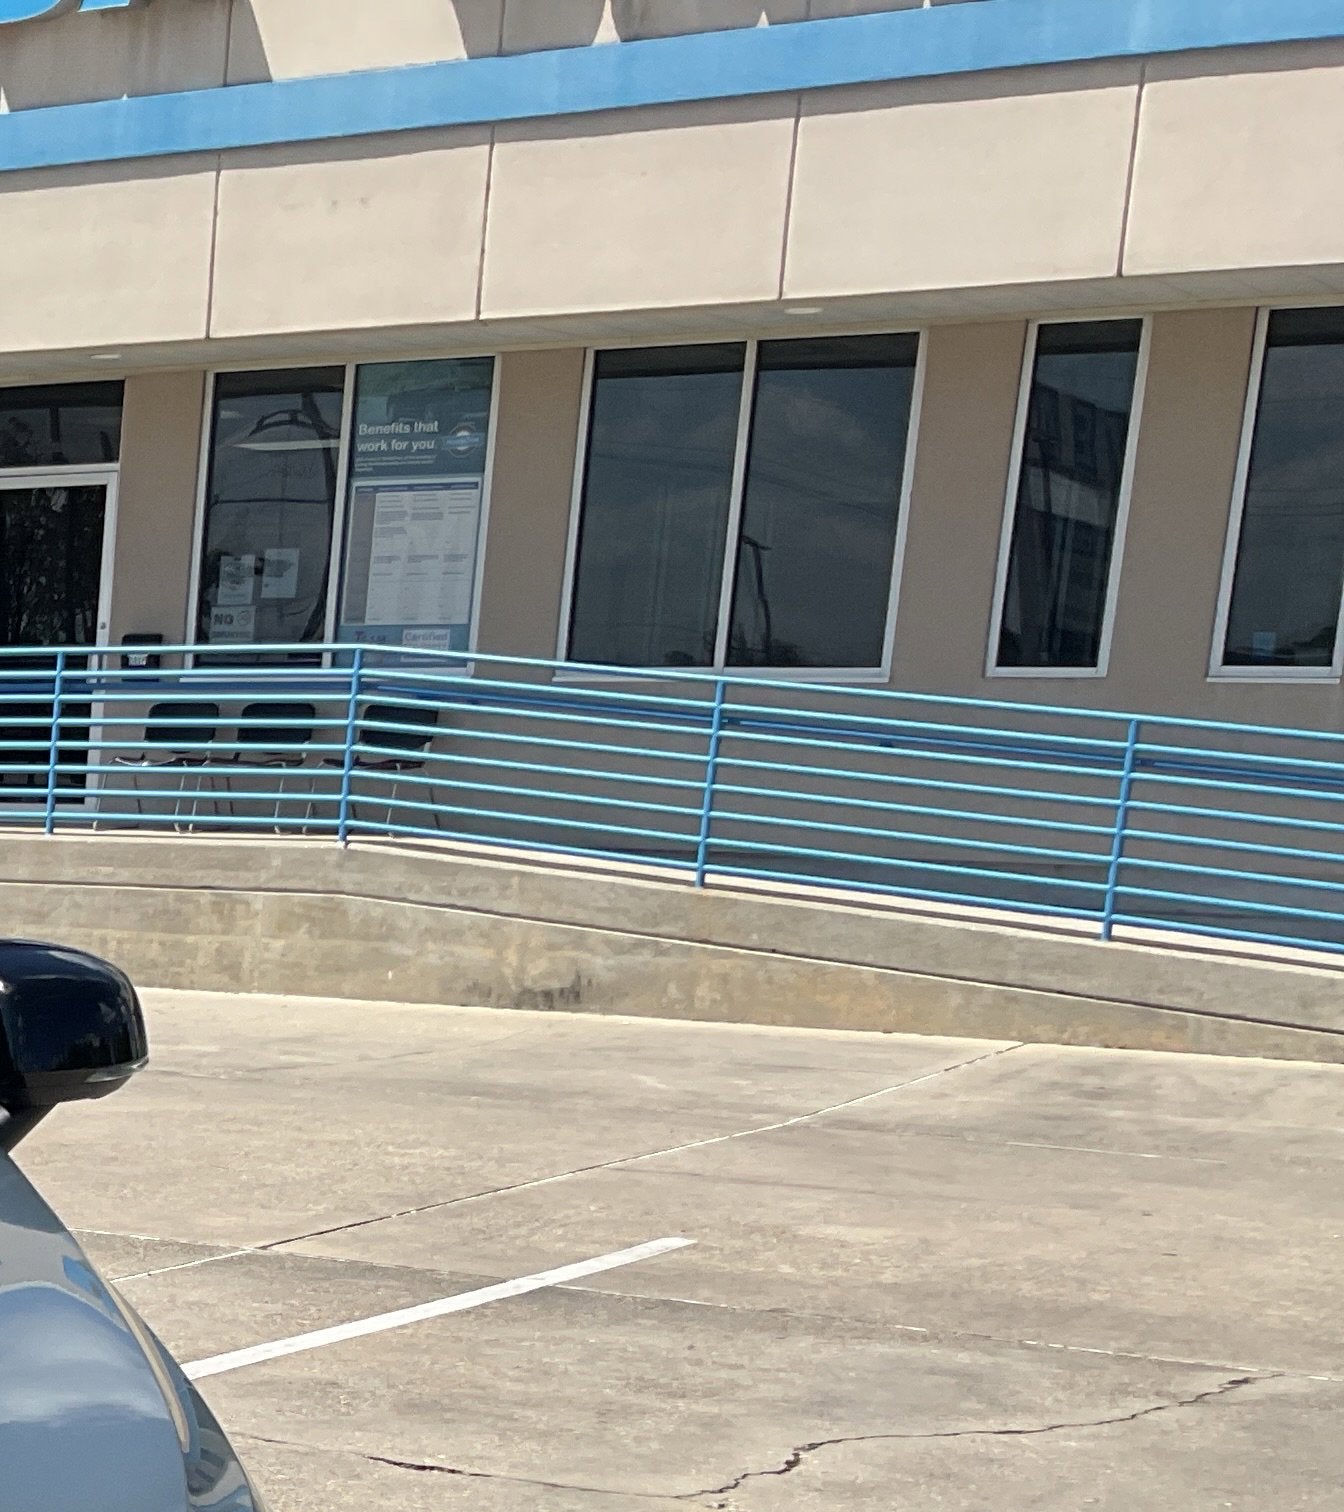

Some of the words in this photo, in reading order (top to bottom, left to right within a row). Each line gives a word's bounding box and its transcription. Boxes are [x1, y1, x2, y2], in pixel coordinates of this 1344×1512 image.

[358, 422, 411, 435] Benefits
[413, 421, 439, 433] that
[357, 440, 388, 452] work
[391, 439, 409, 450] for
[411, 440, 435, 452] you
